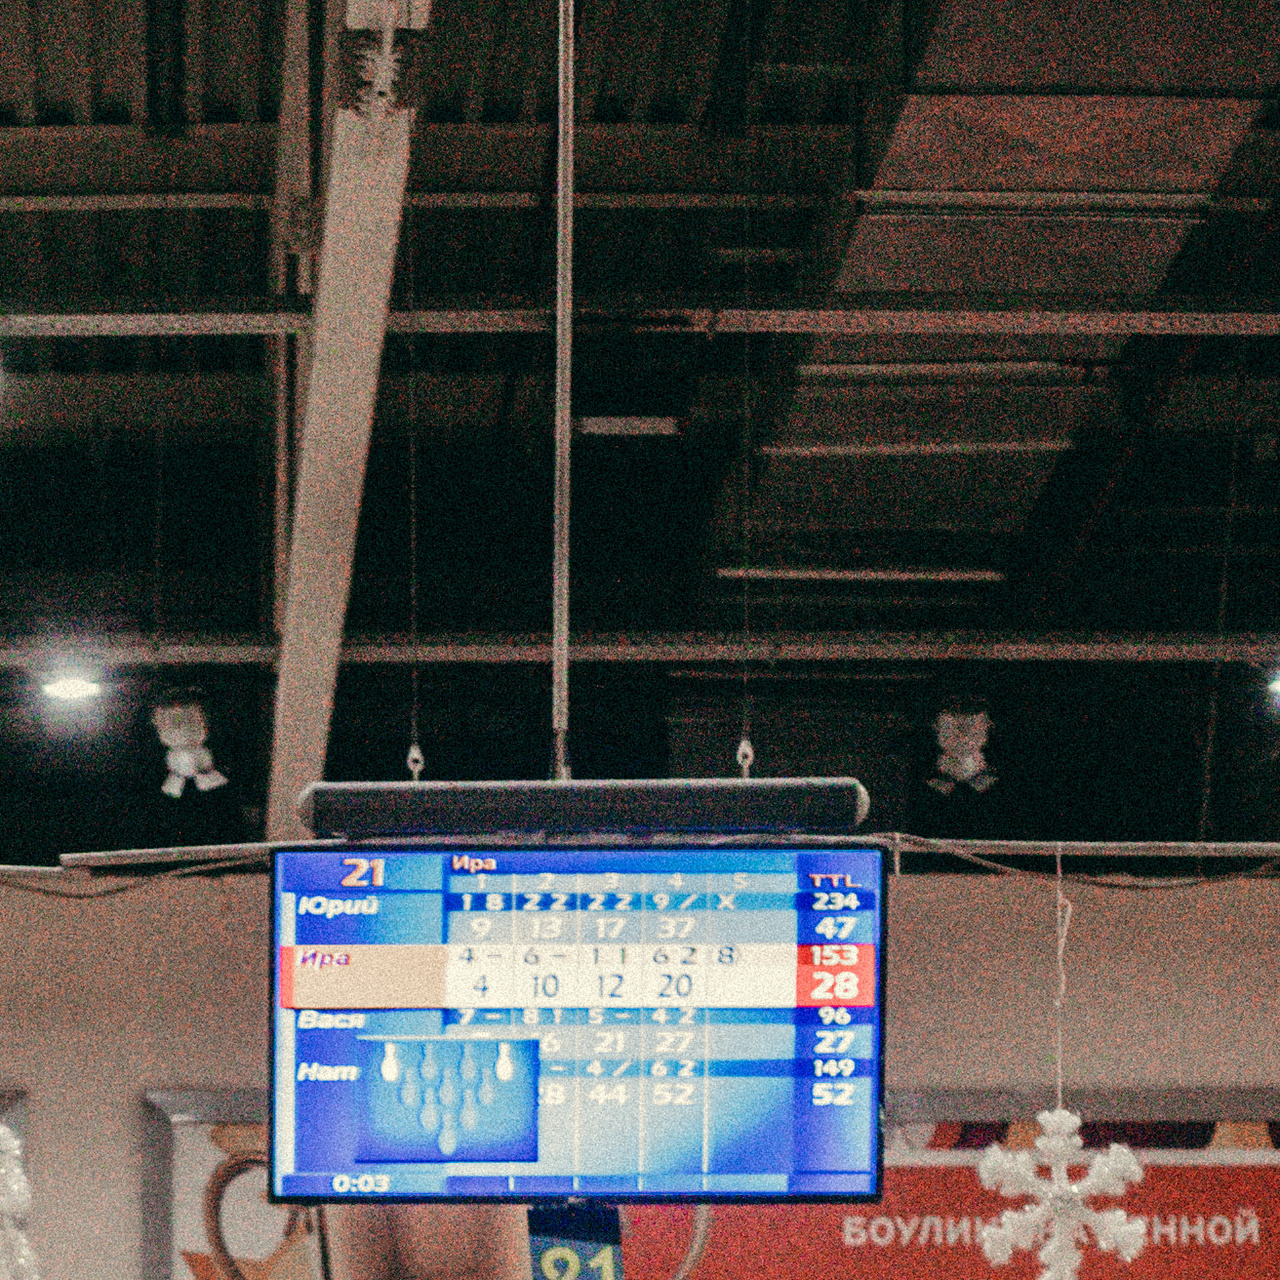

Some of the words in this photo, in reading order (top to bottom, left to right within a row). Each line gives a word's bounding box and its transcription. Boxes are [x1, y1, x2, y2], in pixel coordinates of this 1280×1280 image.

[340, 857, 385, 888] 21
[451, 855, 497, 874] Ира
[537, 873, 555, 891] 2
[603, 873, 620, 891] 3
[666, 873, 684, 891] 4
[733, 873, 749, 891] 5
[808, 874, 862, 888] TTL
[297, 895, 380, 919] Юрий
[812, 892, 860, 911] 234
[470, 917, 492, 940] 9
[532, 917, 563, 940] 13
[596, 917, 626, 940] 17
[657, 917, 696, 940] 37
[815, 916, 858, 940] 47
[298, 949, 352, 971] Ира
[809, 944, 860, 967] 153
[472, 975, 489, 998] 4
[532, 974, 560, 999] 10
[598, 974, 625, 999] 12
[658, 973, 694, 999] 20
[810, 970, 860, 1000] 28
[297, 1009, 366, 1030] Вася
[817, 1006, 852, 1025] 96
[593, 1031, 626, 1053] 21
[655, 1031, 695, 1053] 27
[814, 1030, 856, 1054] 27
[813, 1058, 856, 1078] 149
[588, 1083, 628, 1106] 44
[652, 1083, 695, 1106] 52
[812, 1083, 856, 1106] 52
[332, 1174, 391, 1193] 0:03
